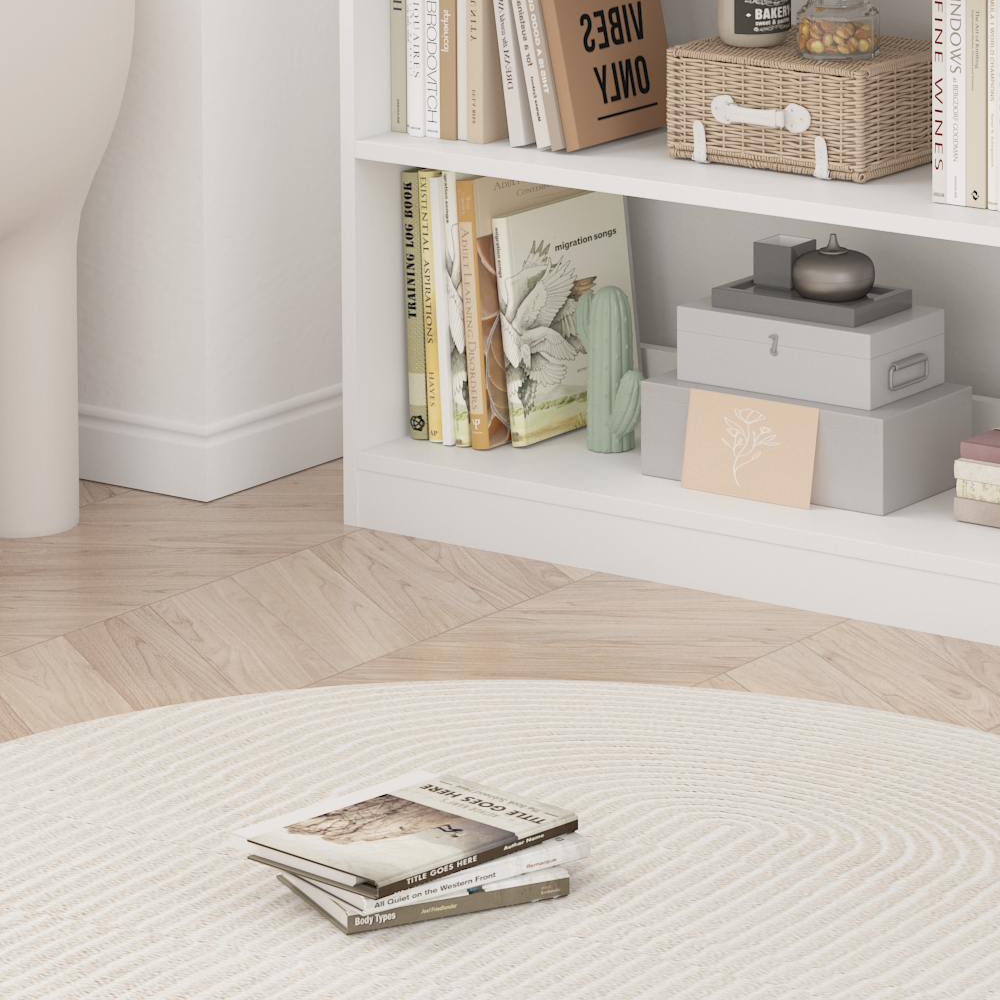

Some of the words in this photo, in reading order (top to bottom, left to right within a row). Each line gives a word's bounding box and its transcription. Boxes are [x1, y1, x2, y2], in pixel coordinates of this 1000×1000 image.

[934, 1, 943, 63] FINE
[426, 1, 438, 123] BRODOVITCH
[934, 78, 943, 170] WINES
[403, 181, 413, 218] BOOK
[420, 177, 430, 253] EXISTENTIAL
[405, 223, 414, 248] LOG
[460, 227, 470, 270] ADULT
[554, 233, 593, 252] migration
[593, 227, 617, 241] songs
[406, 253, 417, 319] TRAINING
[424, 260, 434, 344] ASPIRATIONS
[463, 272, 473, 338] LEARNING
[428, 371, 436, 407] HAYES
[467, 341, 478, 411] DISORDERS
[418, 783, 461, 798] HERE
[460, 796, 506, 812] GOES
[507, 800, 526, 808] Book
[505, 810, 546, 824] TITLE
[503, 840, 525, 851] Author
[526, 834, 545, 843] Name
[406, 873, 428, 886] TITLE
[429, 862, 454, 878] GOES
[455, 855, 478, 870] HERE
[526, 858, 557, 869] Remarque
[374, 898, 384, 909] All
[386, 891, 409, 906] Quiet
[411, 890, 422, 900] on
[424, 885, 438, 897] the
[440, 877, 473, 894] Western
[475, 872, 496, 885] Front
[420, 906, 430, 915] Joel
[430, 902, 458, 913] Friedlander
[355, 912, 374, 927] Body
[375, 911, 396, 925] Types
